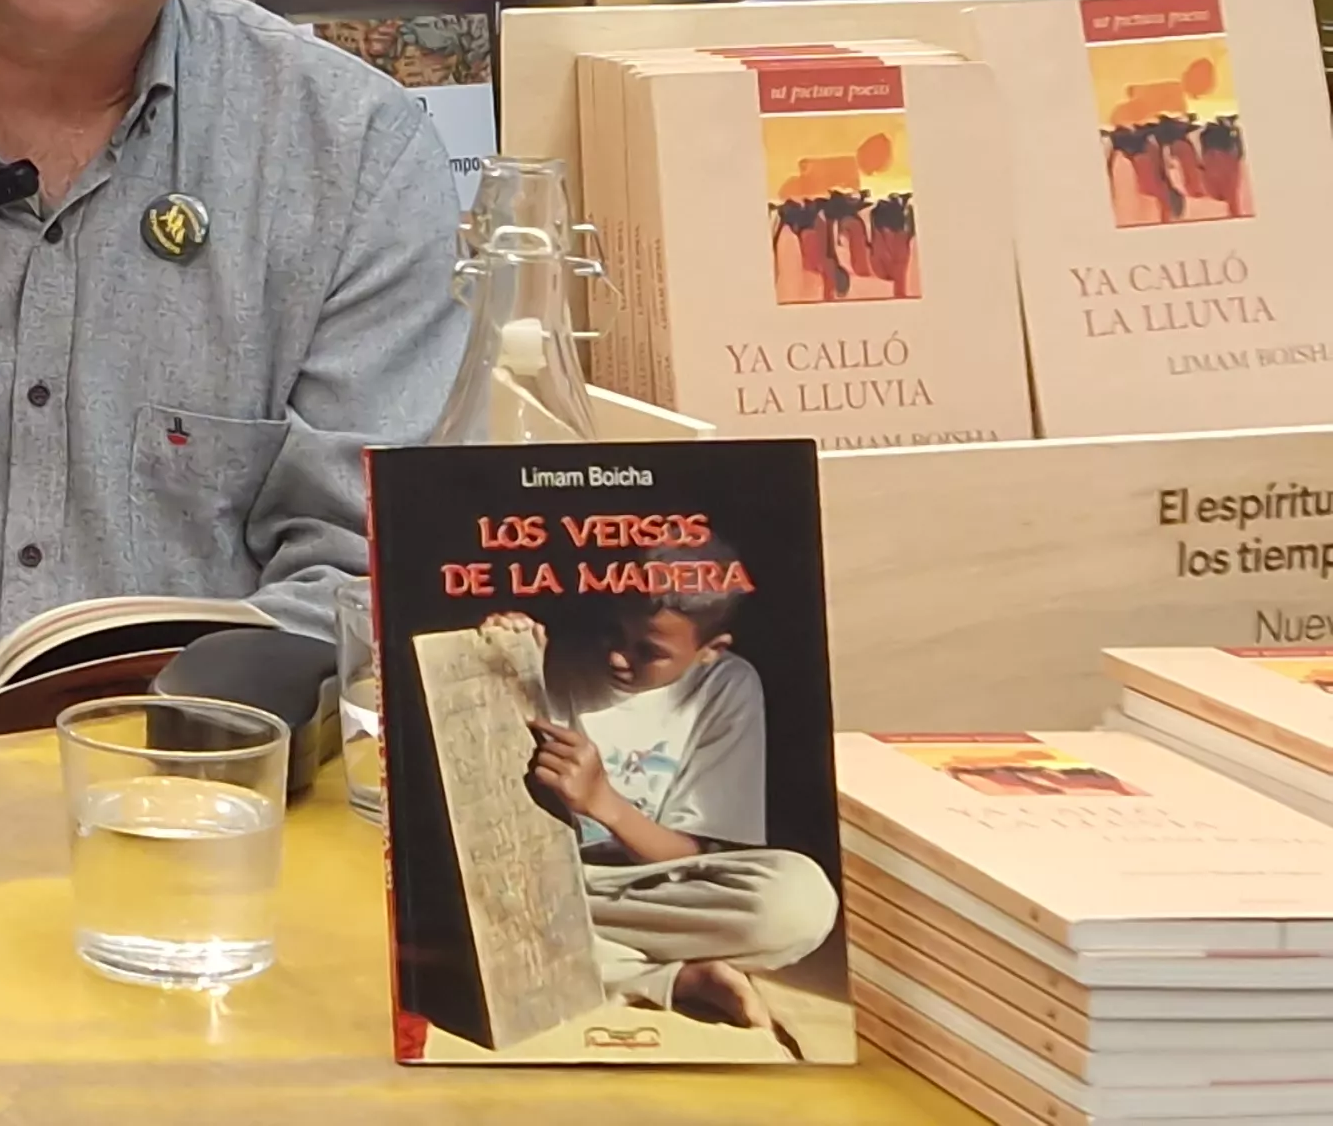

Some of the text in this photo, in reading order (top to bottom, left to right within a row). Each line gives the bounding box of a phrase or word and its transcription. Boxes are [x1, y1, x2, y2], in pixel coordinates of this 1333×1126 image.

[1069, 249, 1249, 299] YA CALLÓ
[1082, 295, 1277, 338] LA LLUVIA
[726, 330, 910, 374] YA CALLÓ
[1167, 343, 1333, 376] LIMAM BOISH
[736, 378, 935, 416] LA LLUVIA
[520, 465, 654, 488] Limam Boicha
[1159, 481, 1333, 531] El espíritu
[477, 513, 713, 549] LOS VERSOS
[440, 560, 757, 597] DE LA MADERA
[1177, 537, 1333, 580] los tiemp
